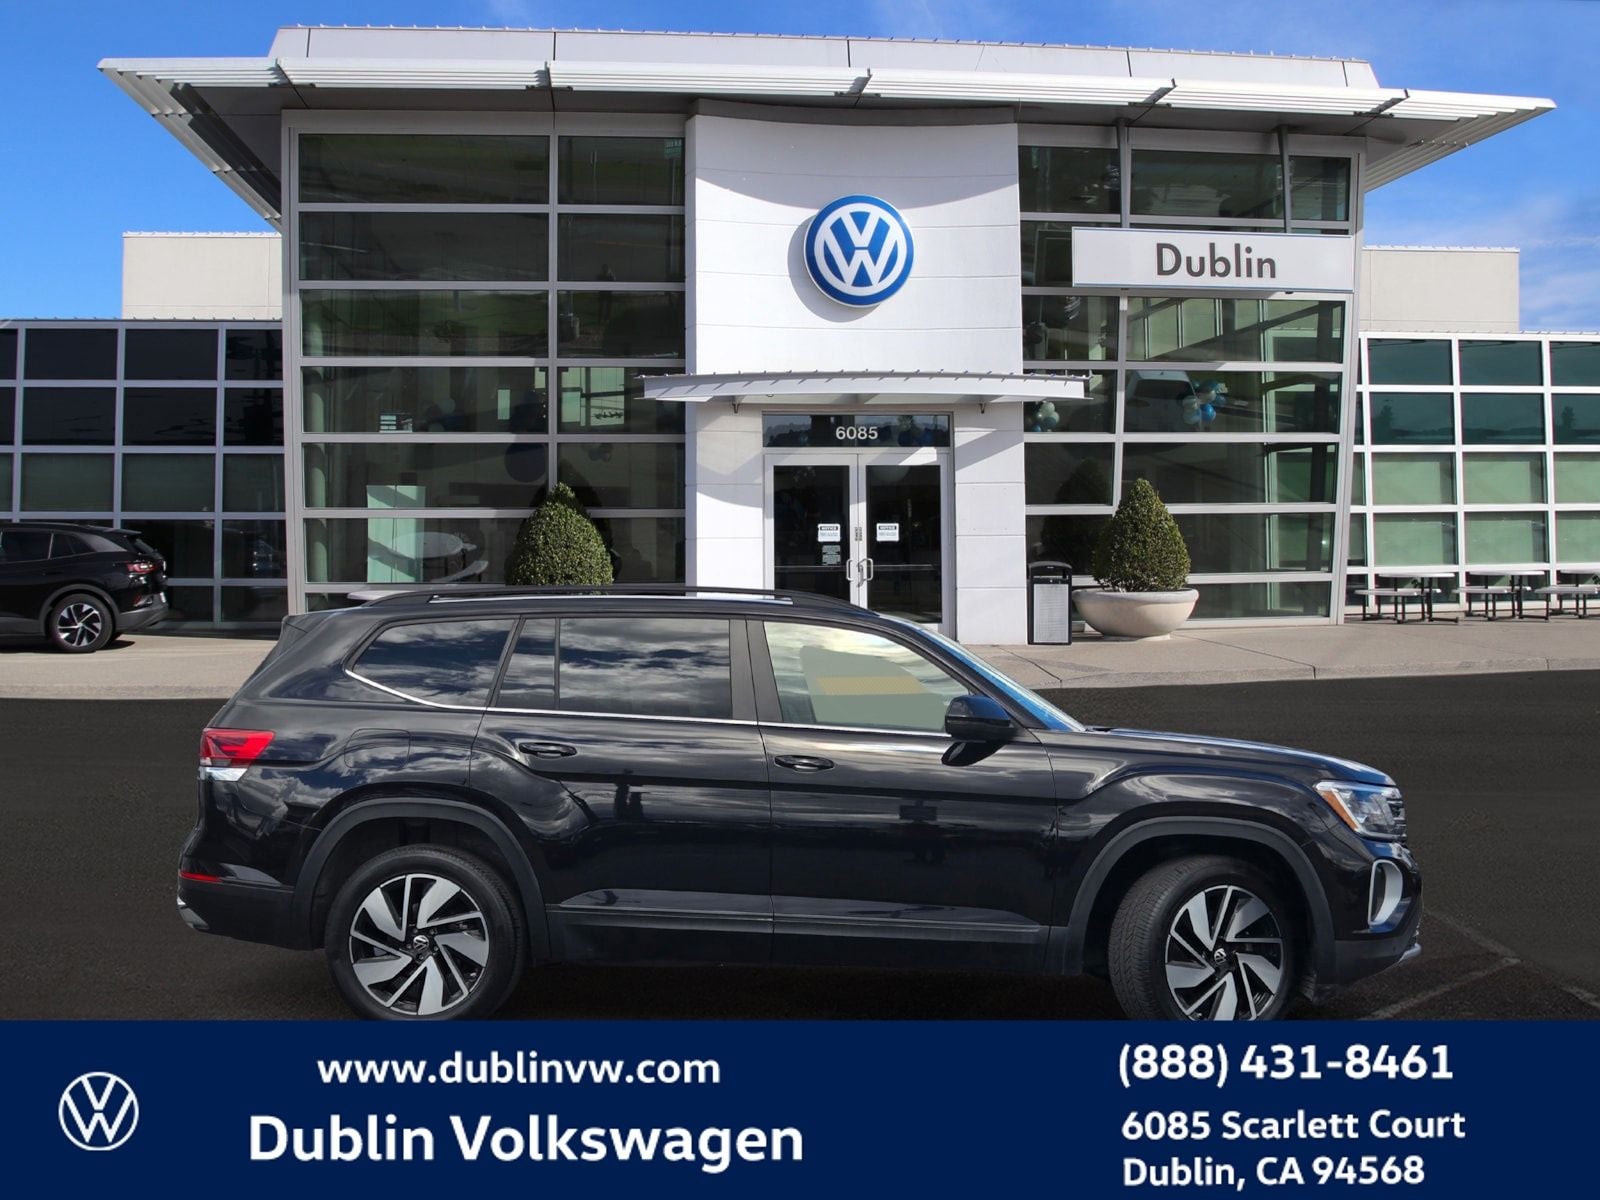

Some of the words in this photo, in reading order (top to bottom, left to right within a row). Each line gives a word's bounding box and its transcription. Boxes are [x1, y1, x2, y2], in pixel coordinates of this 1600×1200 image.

[814, 203, 907, 297] VW
[1156, 242, 1277, 279] Dublin
[835, 426, 878, 440] 6085
